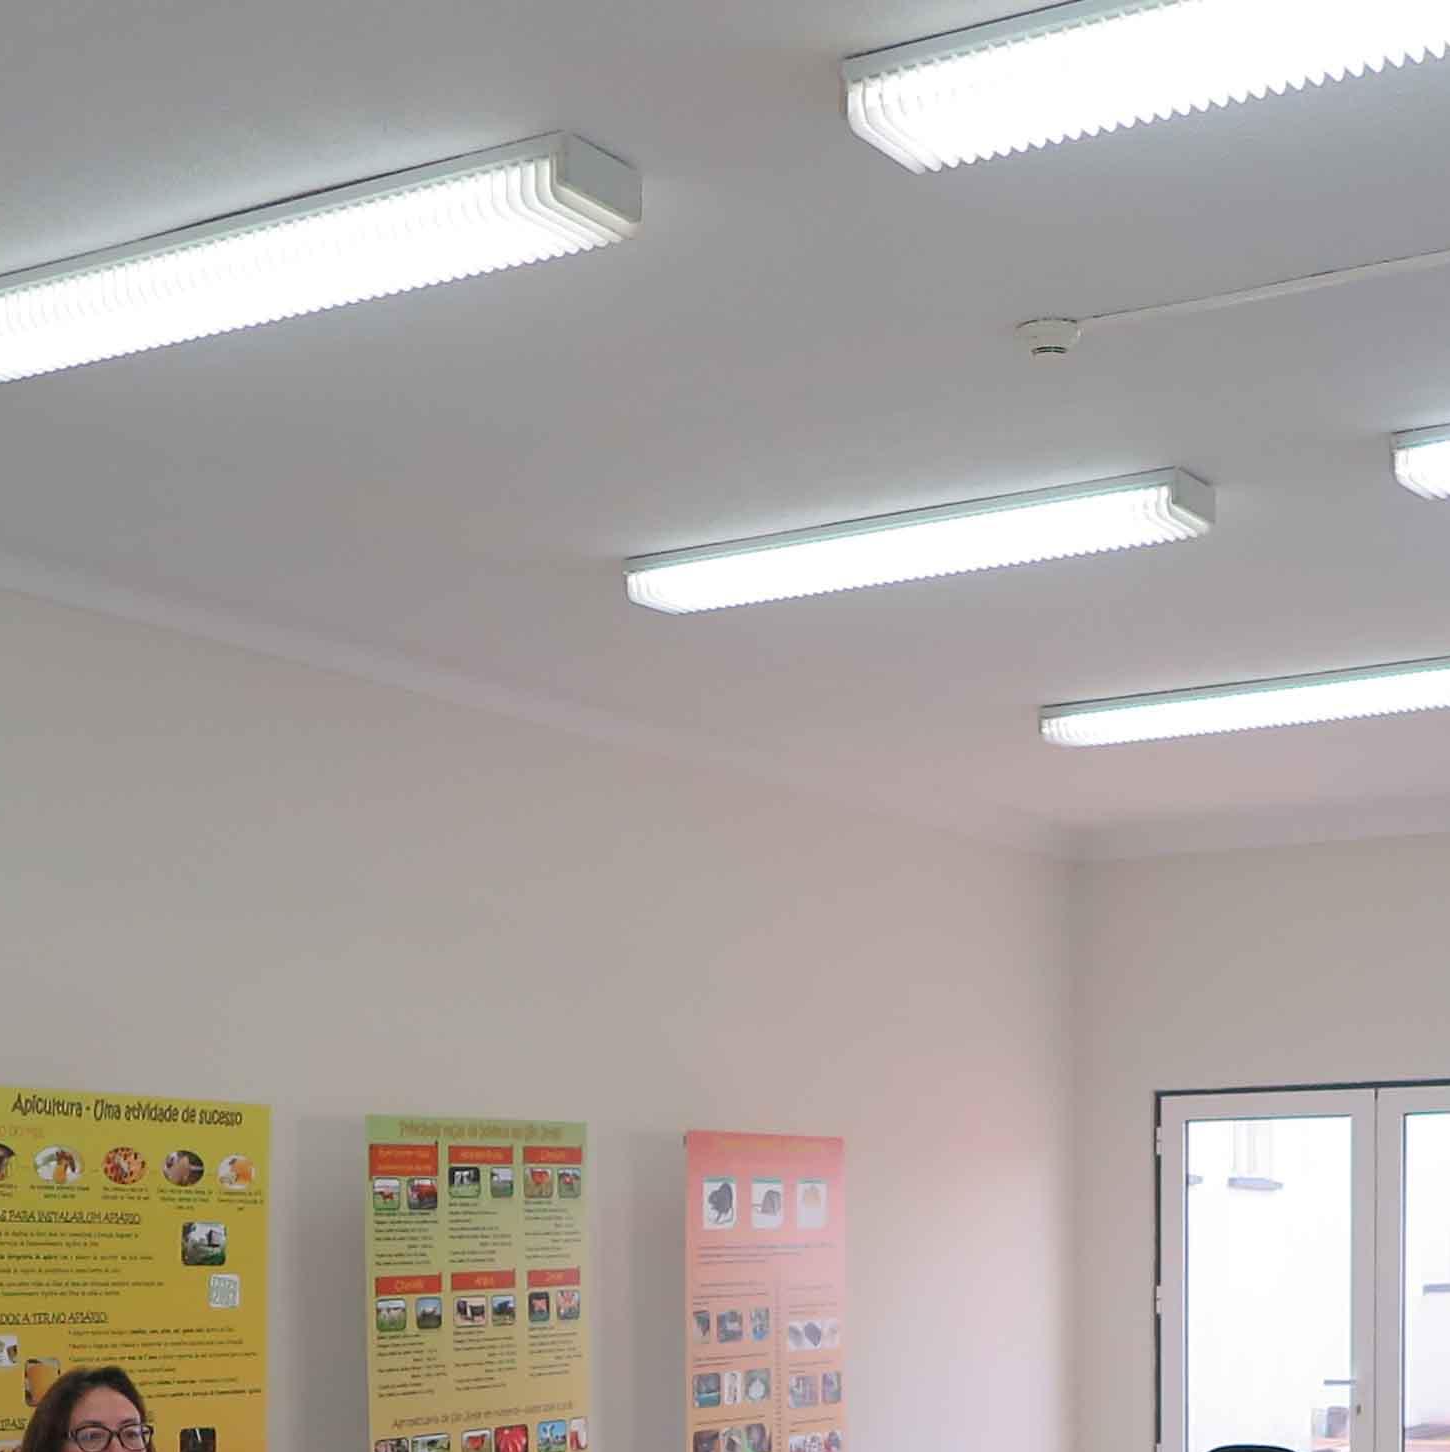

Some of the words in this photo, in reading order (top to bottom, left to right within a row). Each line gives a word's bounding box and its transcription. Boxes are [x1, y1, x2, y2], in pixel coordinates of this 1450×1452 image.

[12, 1093, 82, 1117] Apicultura
[93, 1099, 121, 1121] Uma
[125, 1102, 179, 1123] atividade
[182, 1106, 196, 1124] de
[199, 1108, 242, 1127] sucesso
